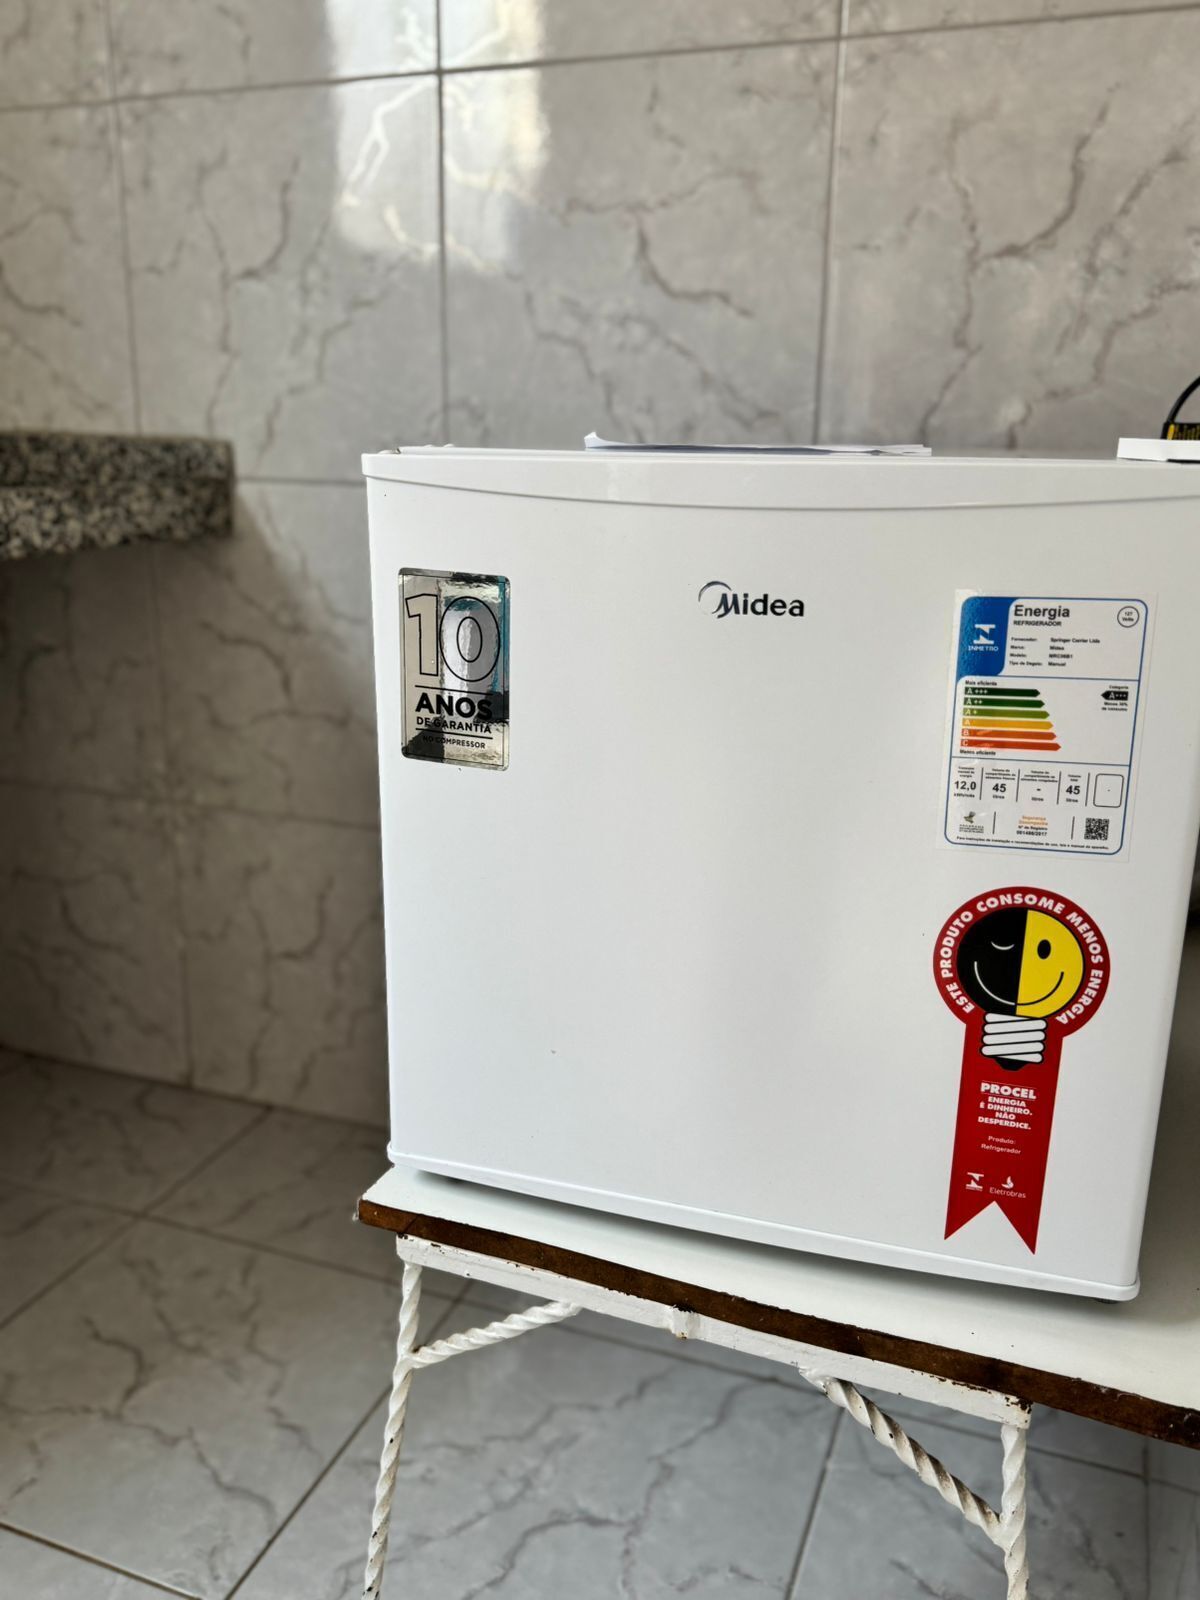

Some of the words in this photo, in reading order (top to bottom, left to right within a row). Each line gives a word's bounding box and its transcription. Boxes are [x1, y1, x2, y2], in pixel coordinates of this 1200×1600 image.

[711, 593, 804, 619] Midea
[1014, 604, 1070, 620] Energia
[405, 593, 501, 683] 10
[415, 692, 493, 721] ANOS
[416, 716, 430, 727] DE
[433, 719, 492, 734] GARANTIA
[422, 734, 434, 743] NO
[437, 737, 486, 750] COMPRESSOR
[954, 780, 977, 791] 12,0
[992, 783, 1007, 793] 45
[1066, 785, 1081, 795] 45
[976, 893, 1066, 915] CONSOME
[940, 911, 974, 979] PRODUTO
[1065, 911, 1104, 964] MENOS
[945, 982, 975, 1014] ESTE
[1055, 969, 1104, 1025] ENERGIA
[980, 1082, 1037, 1100] PROCEL
[979, 1101, 985, 1109] É
[987, 1103, 1033, 1116] DINHEIRO.
[987, 1096, 1026, 1107] ENERGIA
[977, 1116, 1032, 1130] DESPERDICE.
[995, 1111, 1016, 1120] NÃO
[988, 1135, 1016, 1145] Produto:
[981, 1143, 1021, 1155] Refrigerador
[989, 1187, 1027, 1199] Eletrobras
